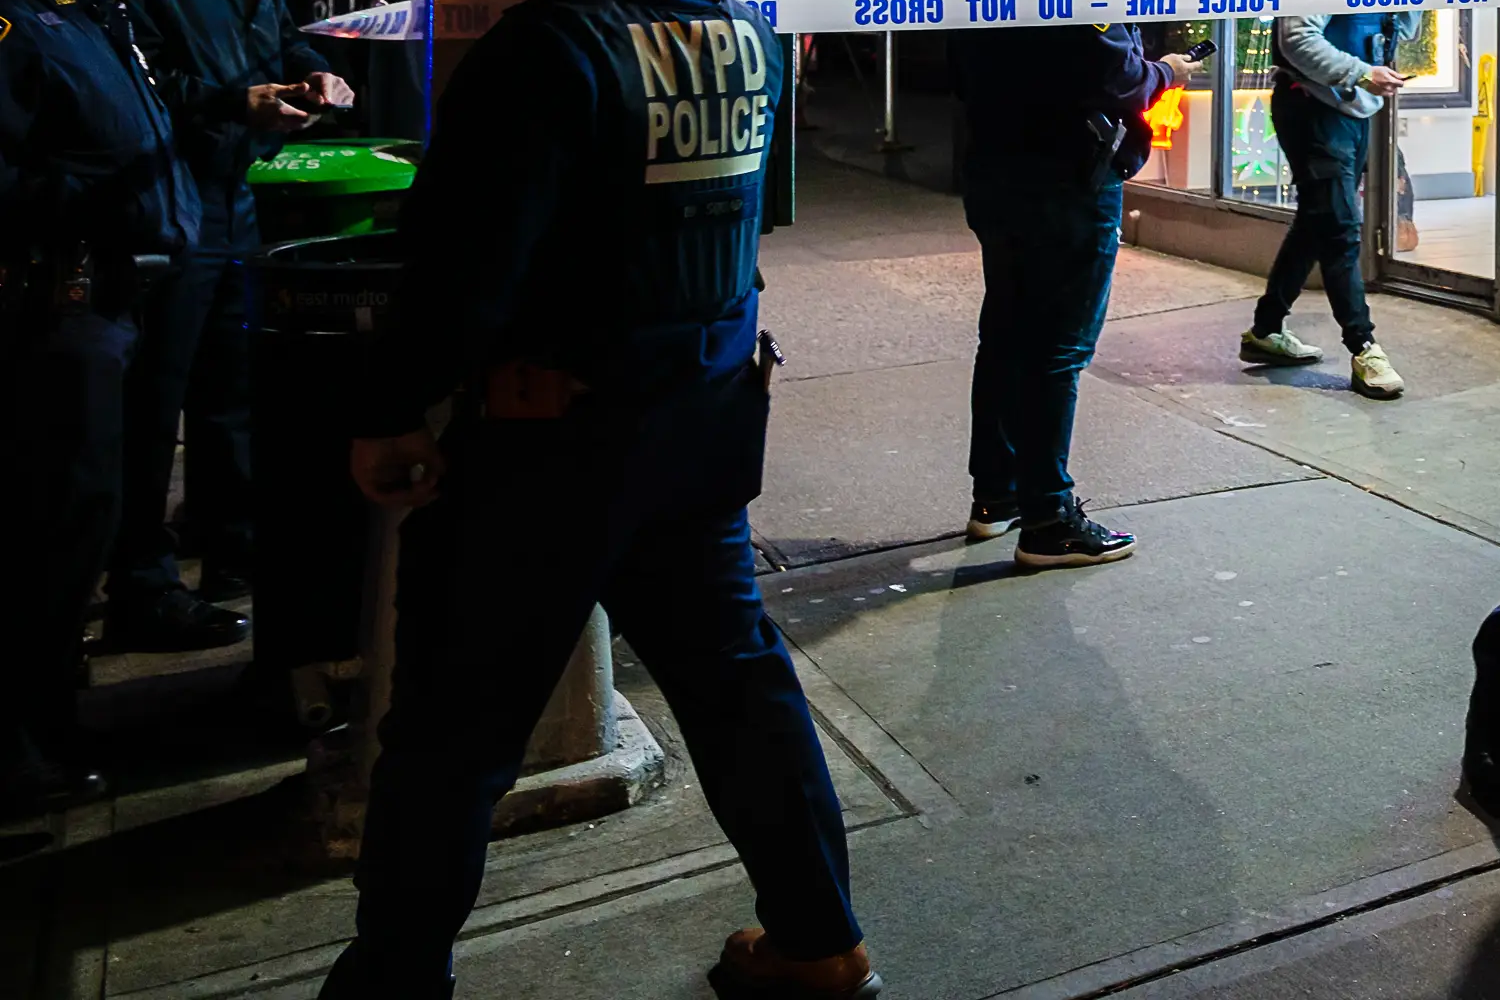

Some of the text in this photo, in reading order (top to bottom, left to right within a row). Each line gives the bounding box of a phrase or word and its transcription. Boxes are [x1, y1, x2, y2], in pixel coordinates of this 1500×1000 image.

[626, 19, 767, 97] NYPD
[647, 95, 768, 160] POLICE
[333, 288, 389, 307] midto
